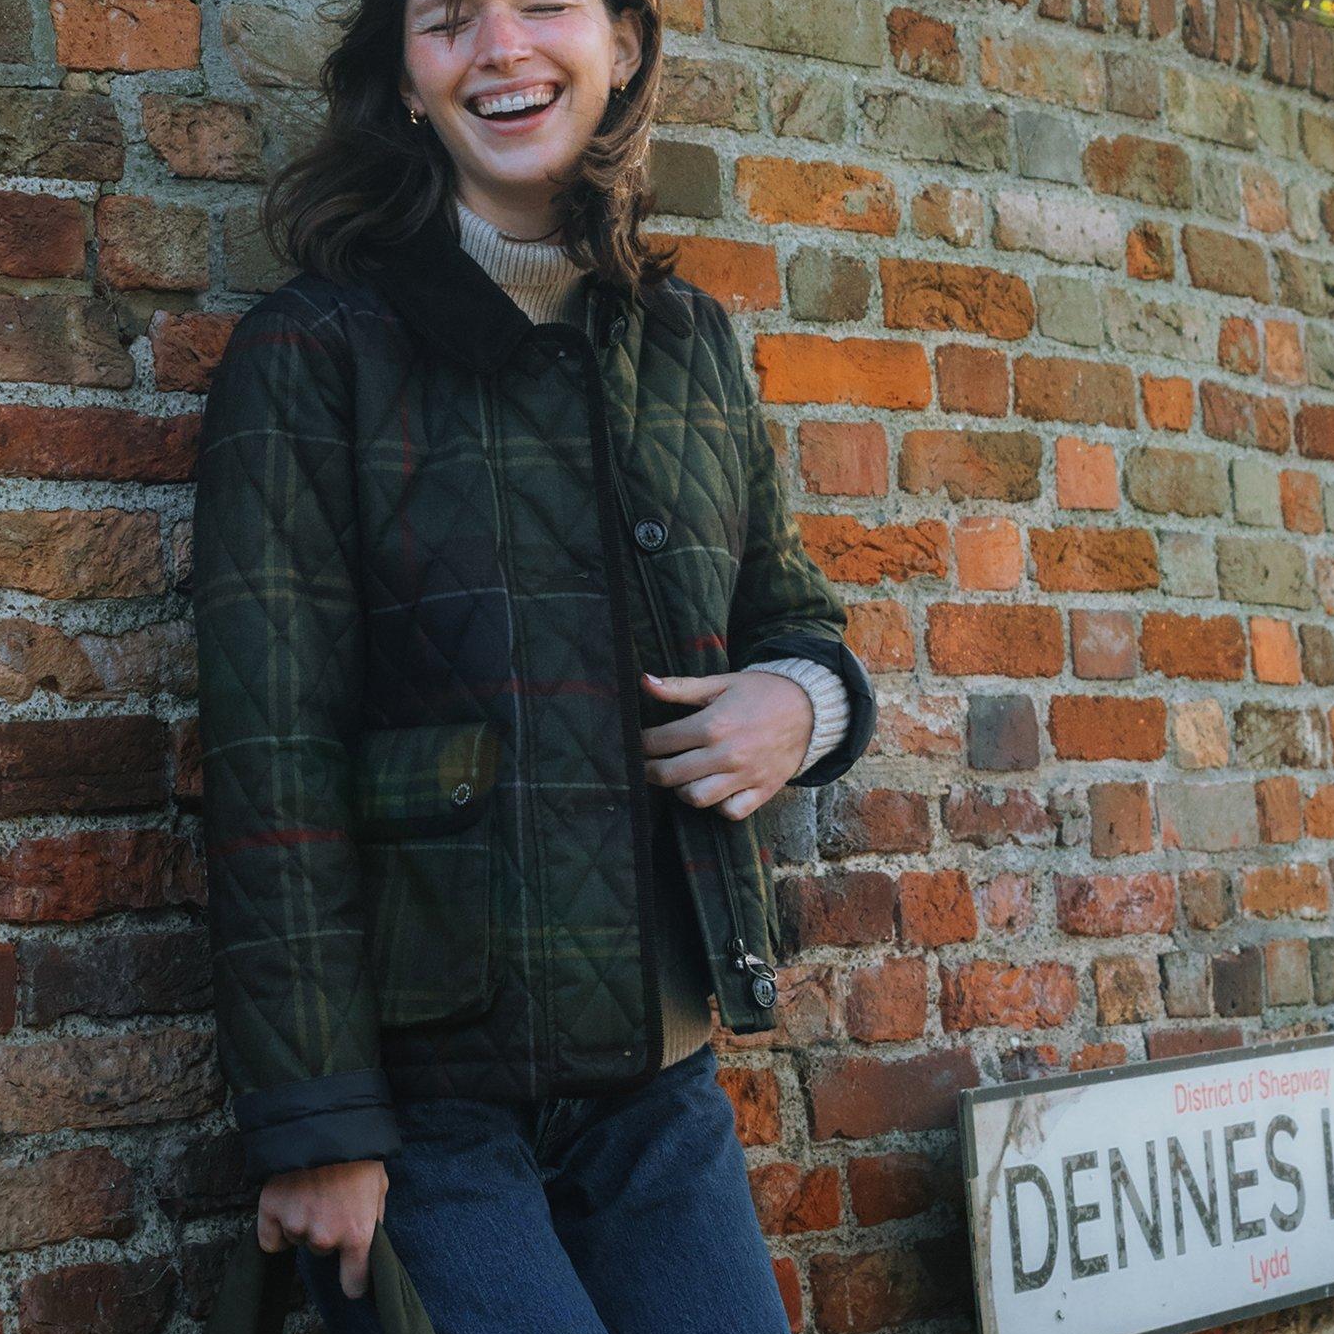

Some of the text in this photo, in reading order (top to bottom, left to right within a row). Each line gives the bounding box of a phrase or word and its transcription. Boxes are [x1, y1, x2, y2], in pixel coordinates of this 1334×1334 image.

[1174, 1068, 1331, 1114] District of Shepway
[1004, 1114, 1306, 1294] DENNES
[1250, 1245, 1291, 1290] Lydd
